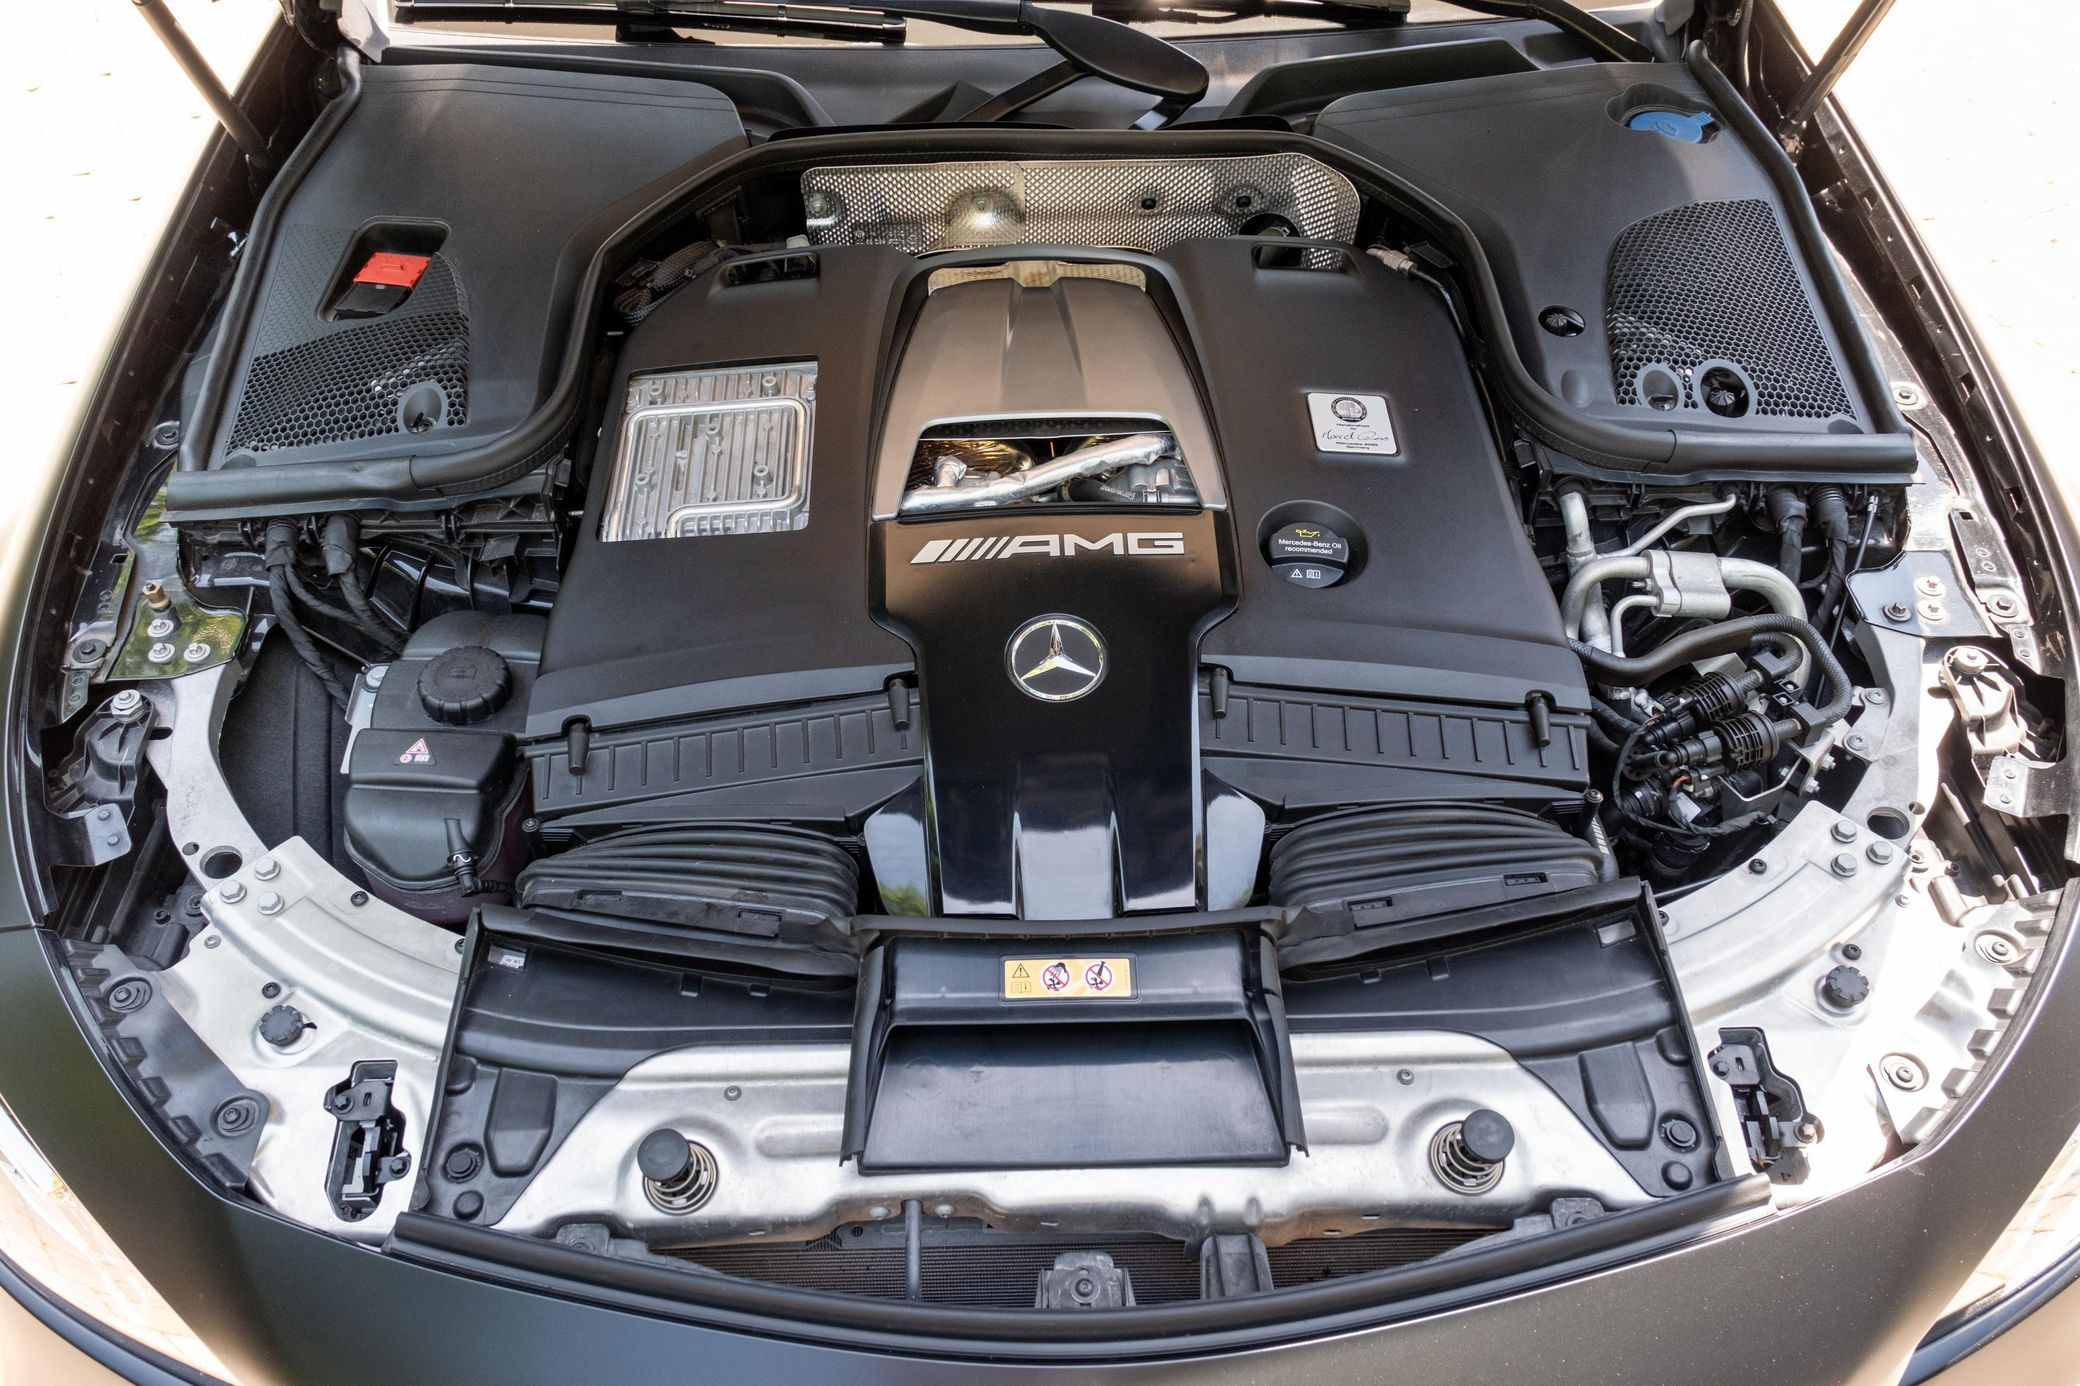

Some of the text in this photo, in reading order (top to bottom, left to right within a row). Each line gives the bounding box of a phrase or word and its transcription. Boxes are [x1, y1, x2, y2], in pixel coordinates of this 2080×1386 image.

[997, 532, 1185, 559] AMG
[1278, 538, 1331, 548] Mercedes-Benz
[1285, 546, 1333, 554] recommended
